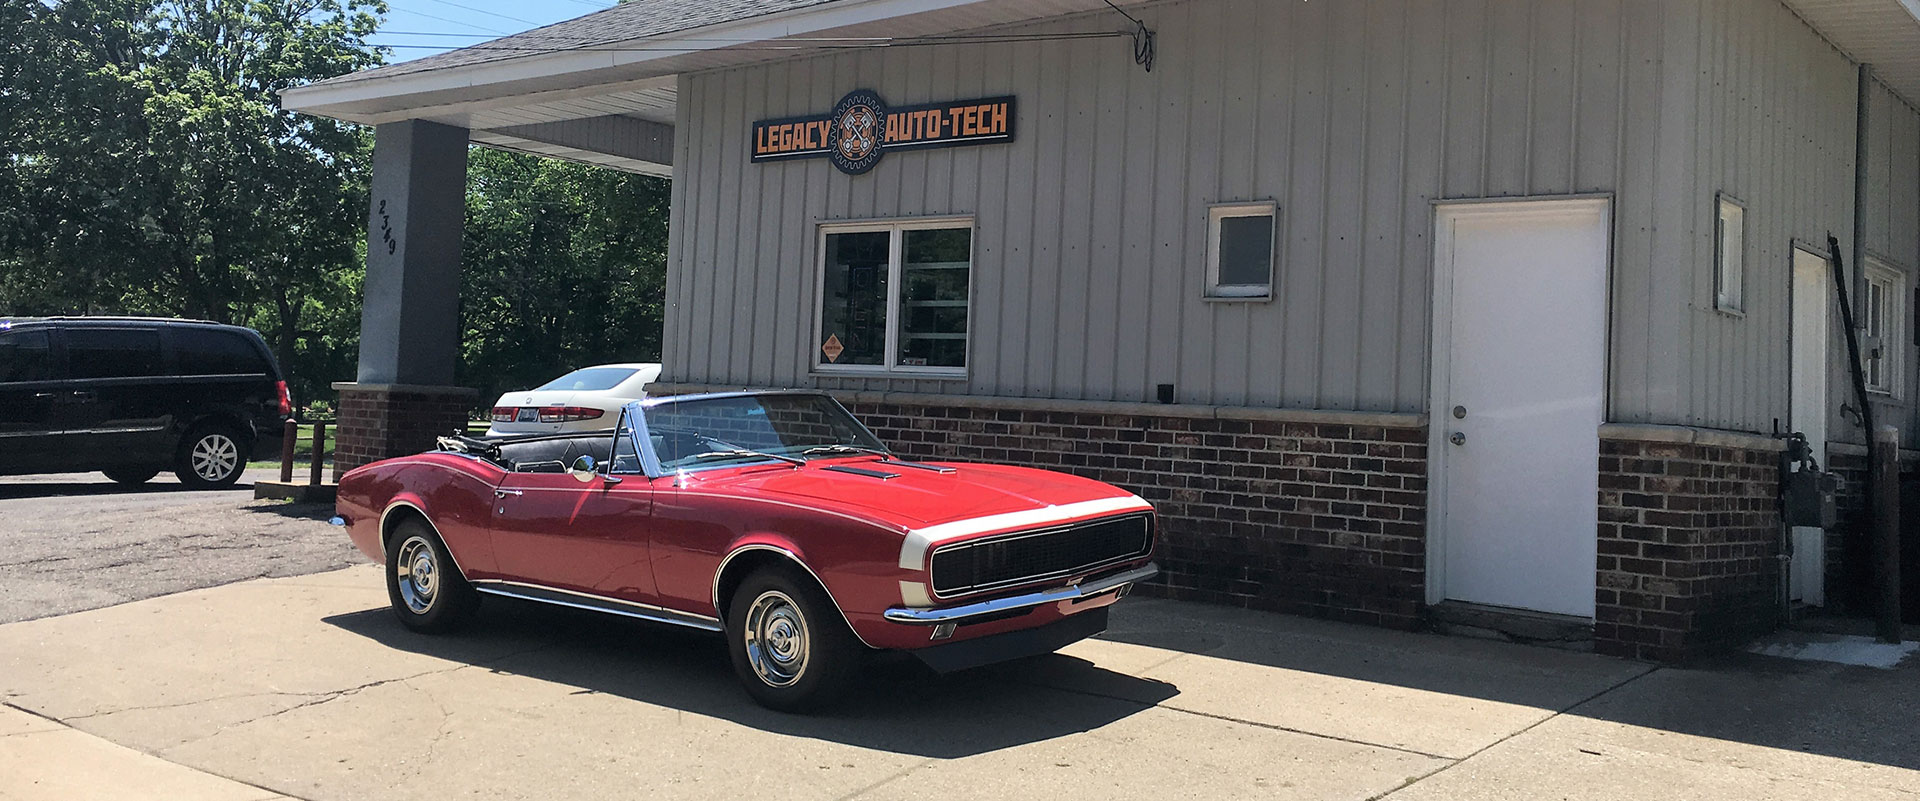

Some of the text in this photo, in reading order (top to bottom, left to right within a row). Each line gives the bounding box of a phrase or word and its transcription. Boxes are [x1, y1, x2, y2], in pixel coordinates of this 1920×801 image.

[757, 103, 1008, 153] LEGACY AUTO-TECH
[379, 199, 396, 255] 2349
